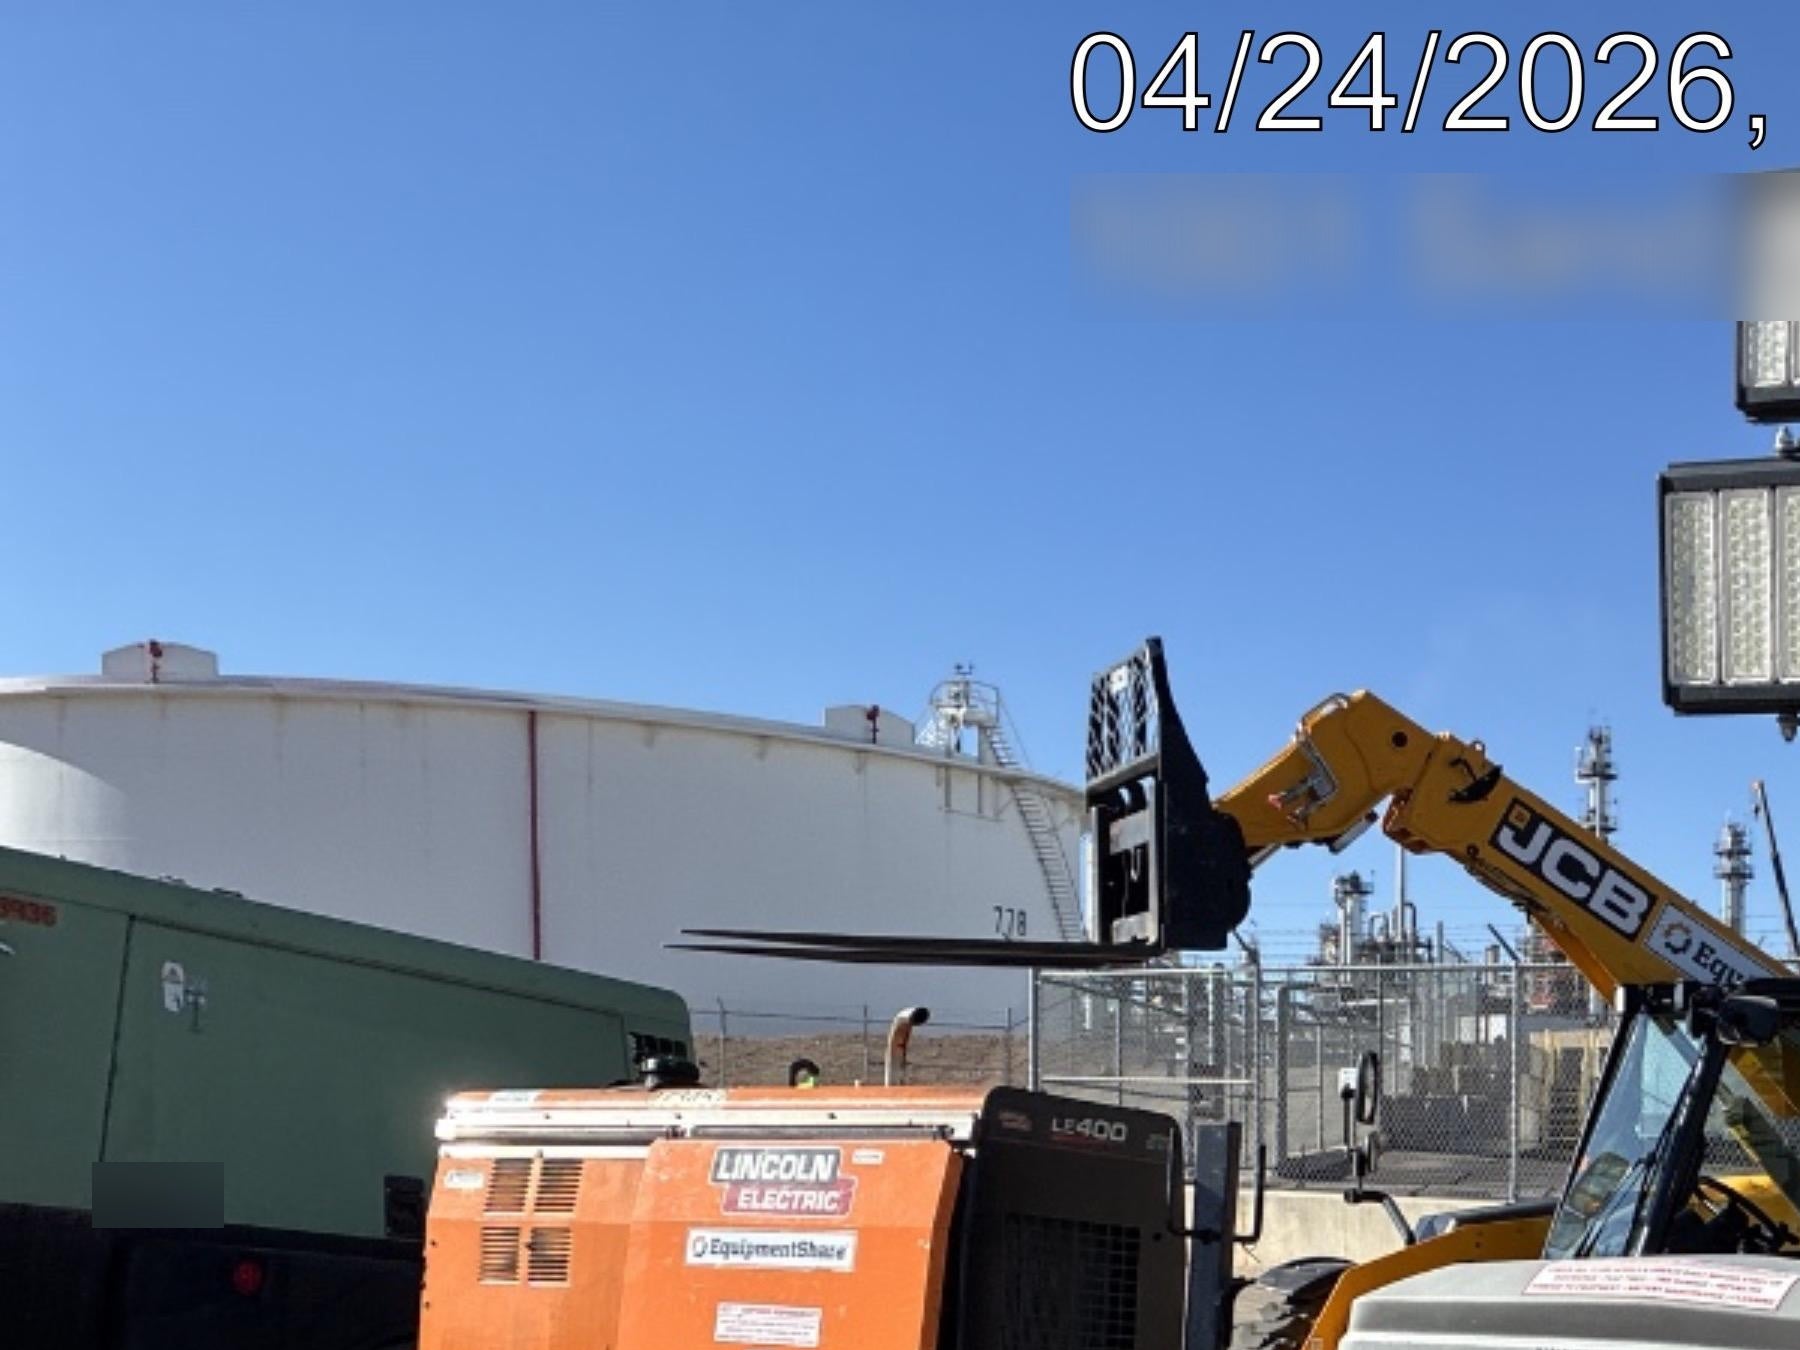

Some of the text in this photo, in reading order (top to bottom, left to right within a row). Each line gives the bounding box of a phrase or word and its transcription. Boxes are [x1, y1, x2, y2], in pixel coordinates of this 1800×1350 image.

[1497, 820, 1651, 936] JCB
[1052, 1117, 1127, 1142] LE400
[715, 1152, 836, 1181] LINCOLN
[736, 1188, 841, 1211] ELECTRIC
[709, 1238, 848, 1262] EquipmentShare
